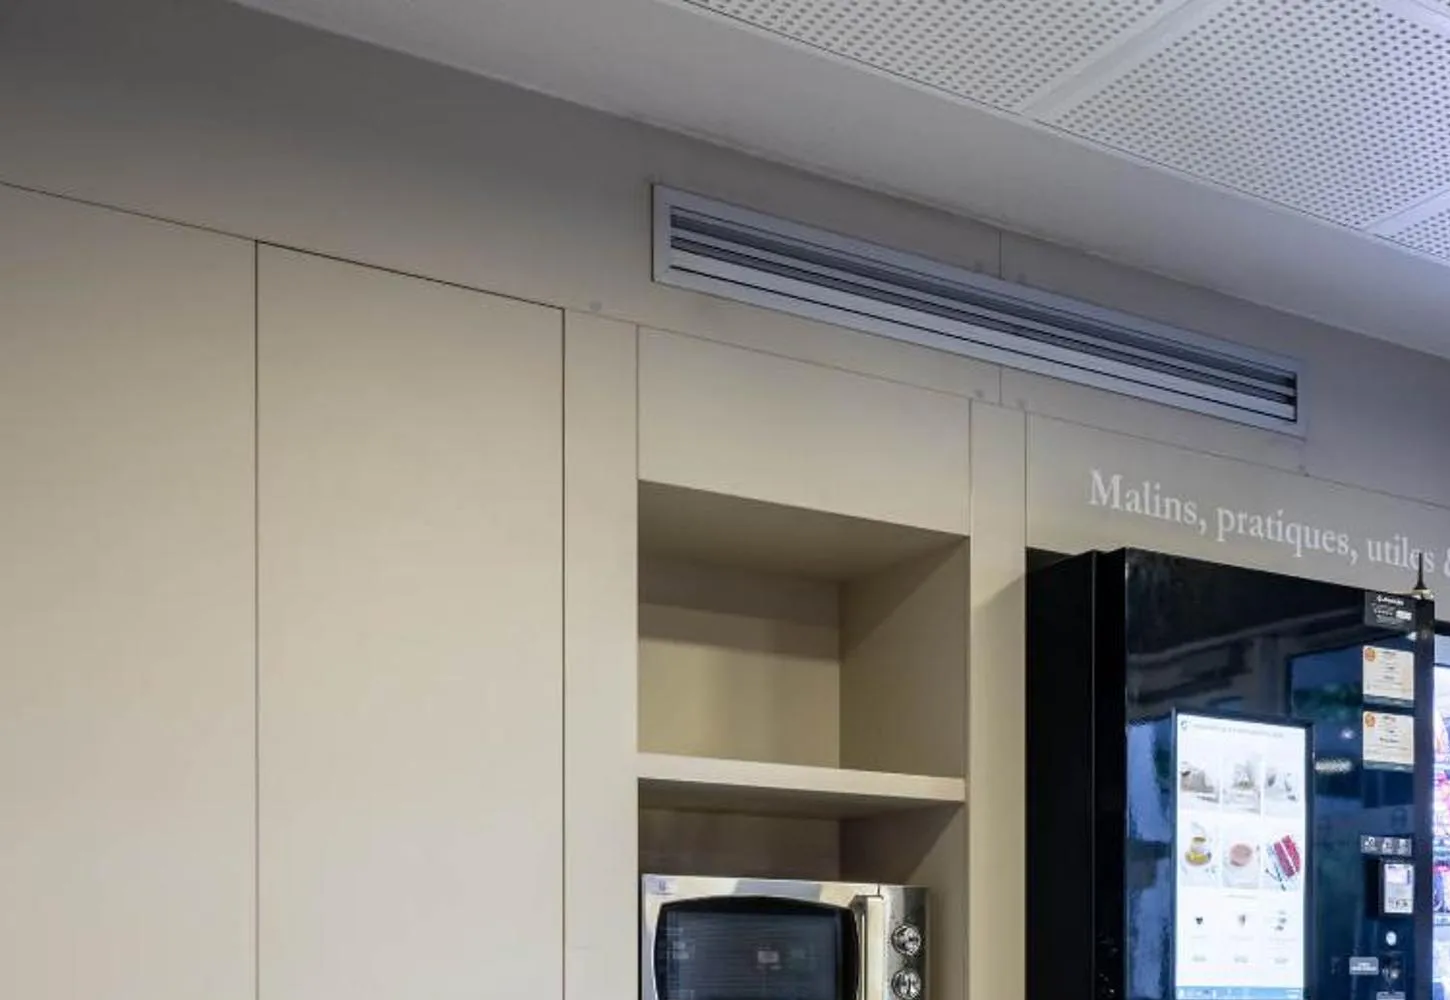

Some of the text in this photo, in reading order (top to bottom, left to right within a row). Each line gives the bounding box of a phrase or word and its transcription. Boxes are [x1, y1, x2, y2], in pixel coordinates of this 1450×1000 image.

[1088, 469, 1207, 535] Malins,
[1216, 508, 1359, 565] pratiques,
[1366, 534, 1436, 573] utiles
